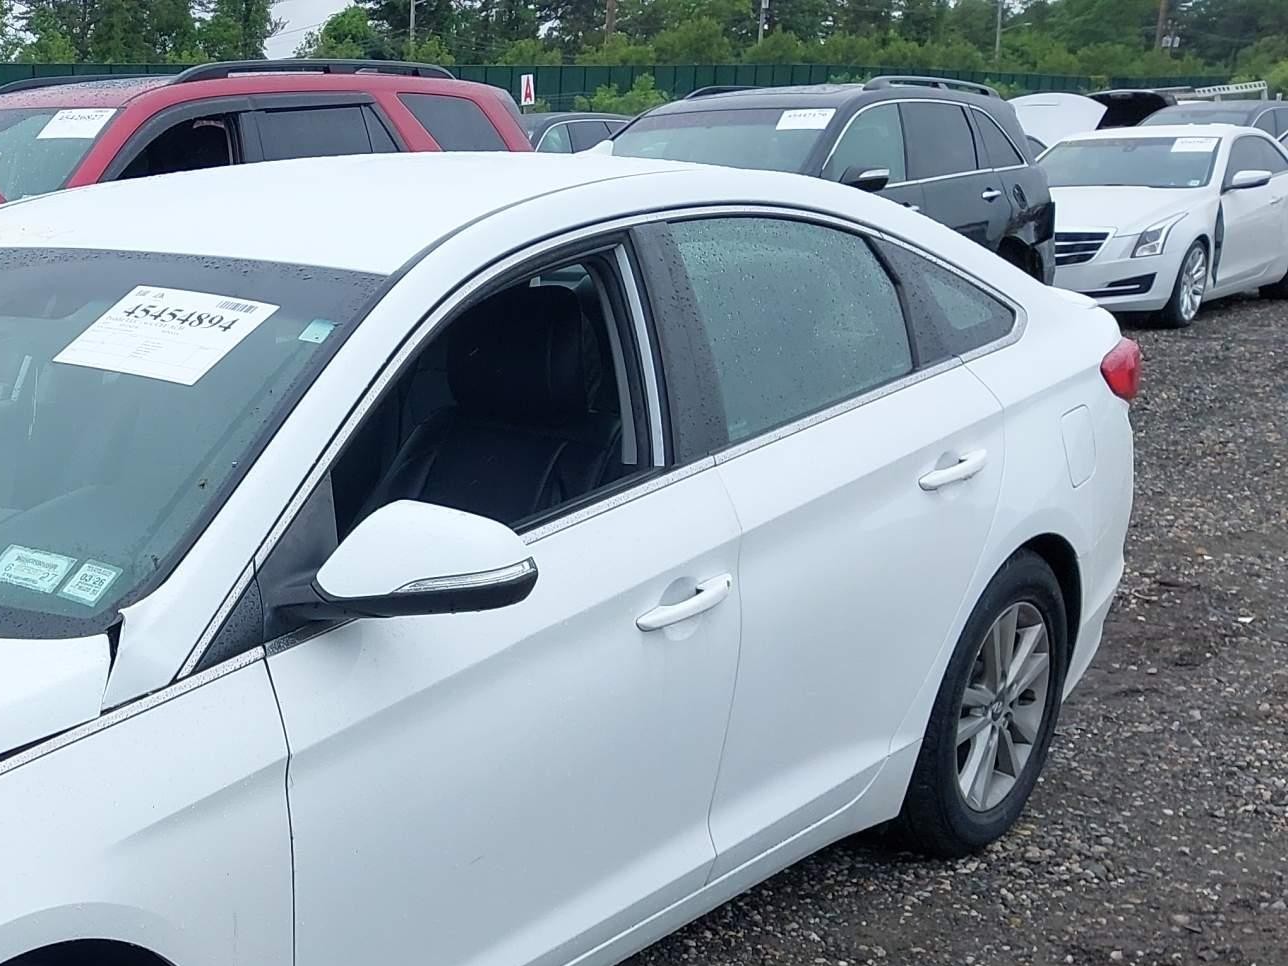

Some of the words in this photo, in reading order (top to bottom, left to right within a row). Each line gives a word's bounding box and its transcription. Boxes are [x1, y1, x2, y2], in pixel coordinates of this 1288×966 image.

[523, 75, 533, 103] A
[123, 303, 240, 332] 45454894
[39, 571, 58, 583] 27
